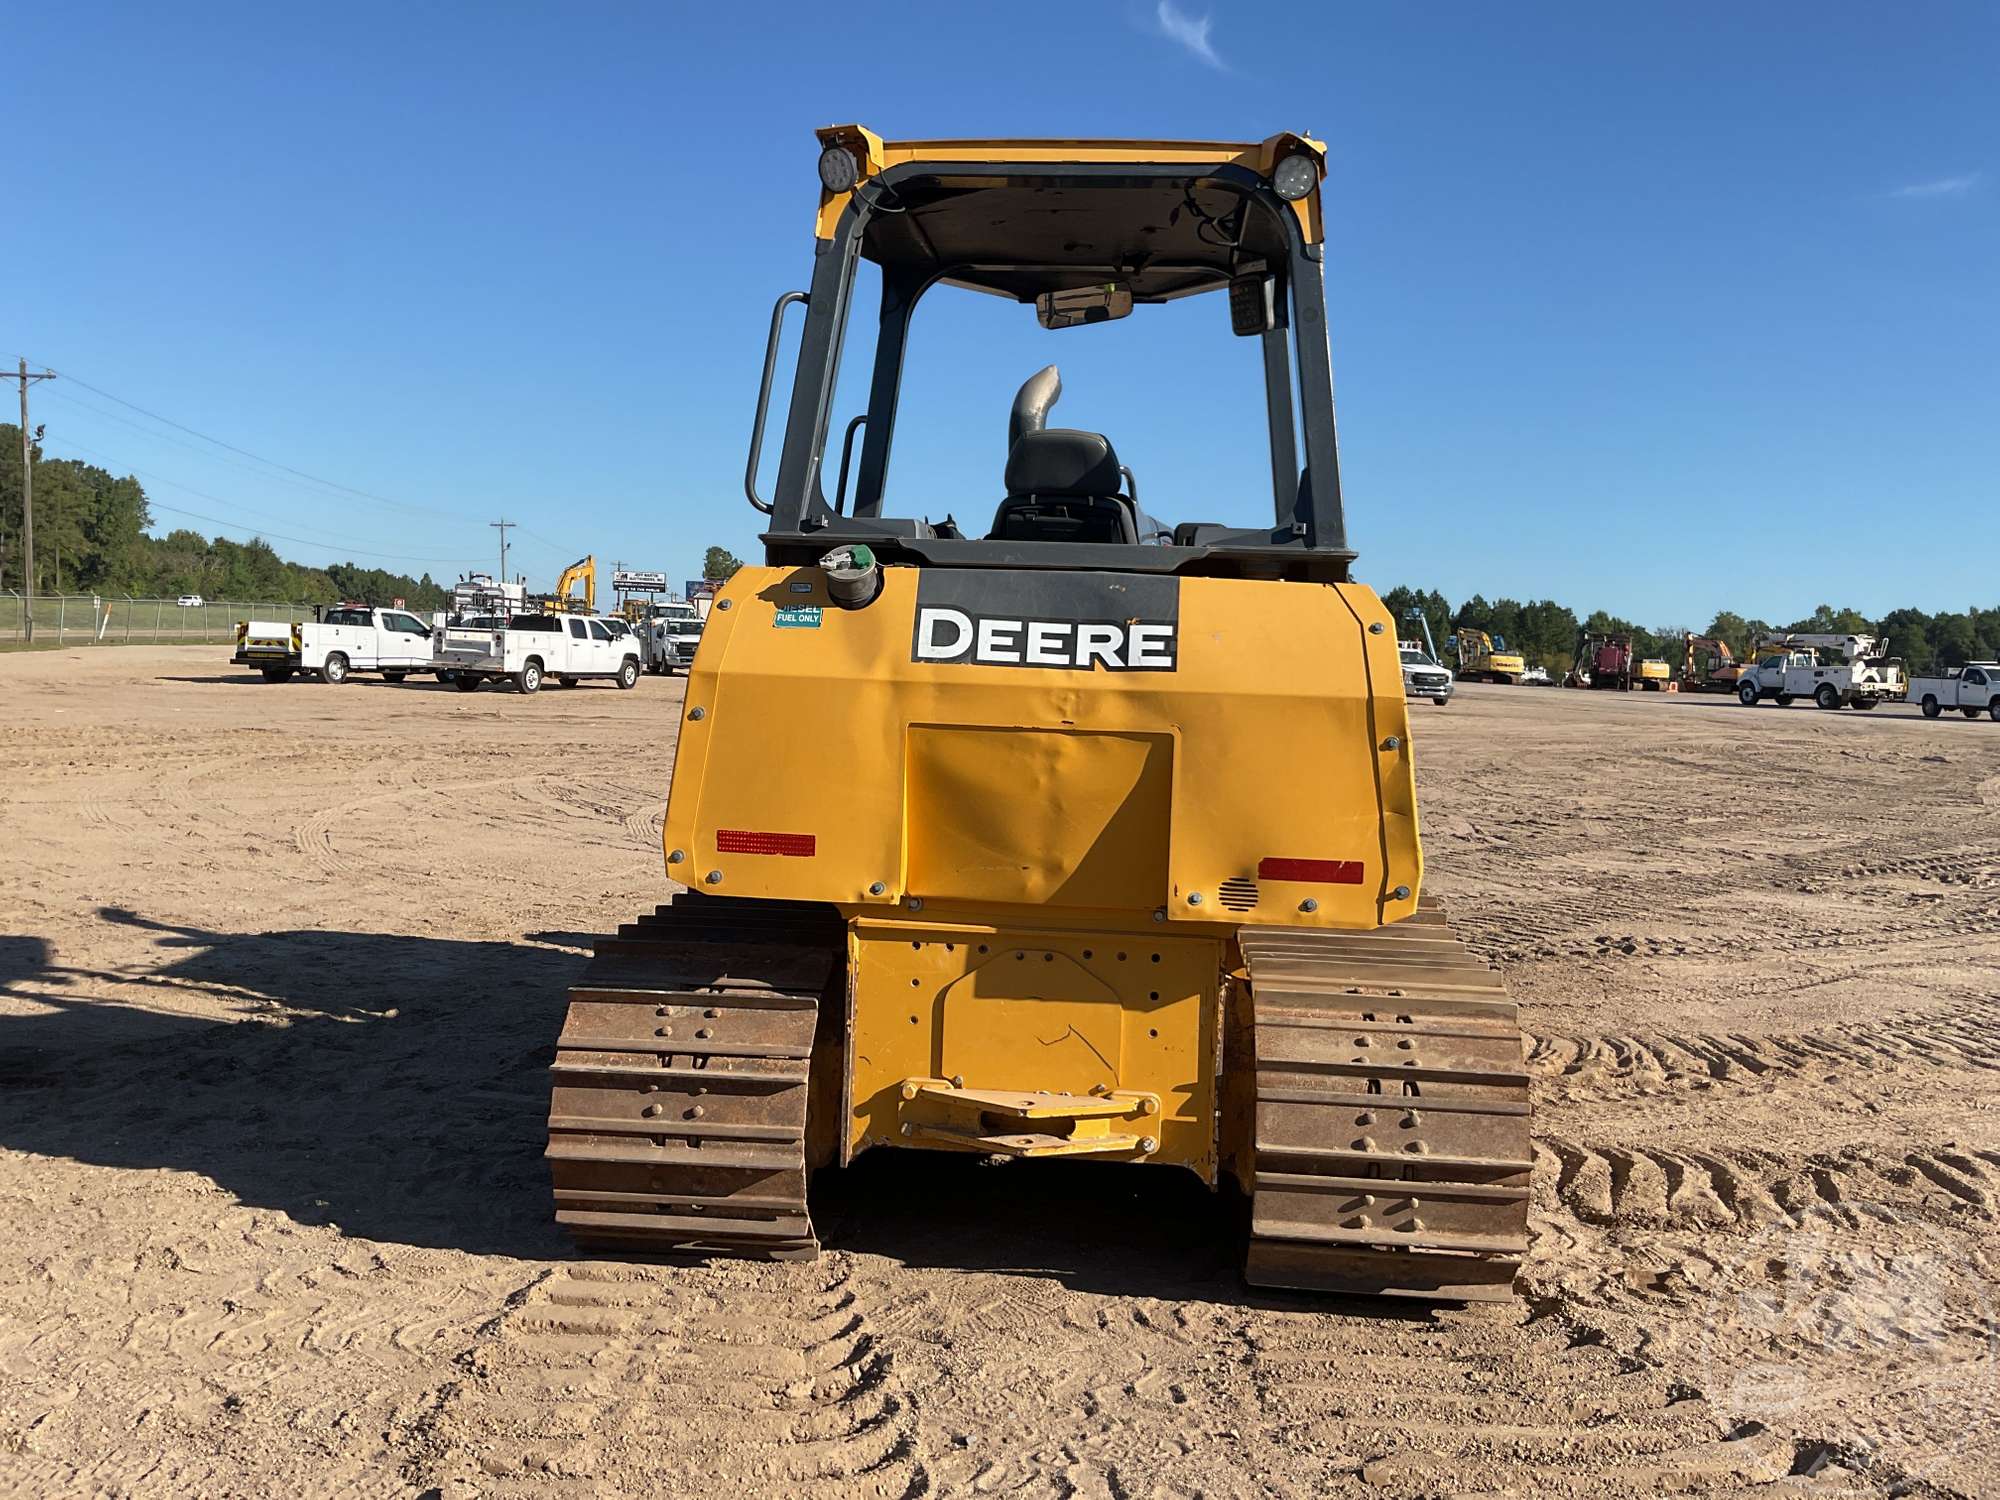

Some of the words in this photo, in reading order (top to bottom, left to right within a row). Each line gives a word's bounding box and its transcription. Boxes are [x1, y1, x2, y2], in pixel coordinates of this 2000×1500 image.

[777, 613, 797, 622] FUEL
[798, 614, 819, 623] ONLY
[917, 607, 1174, 667] DEERE
